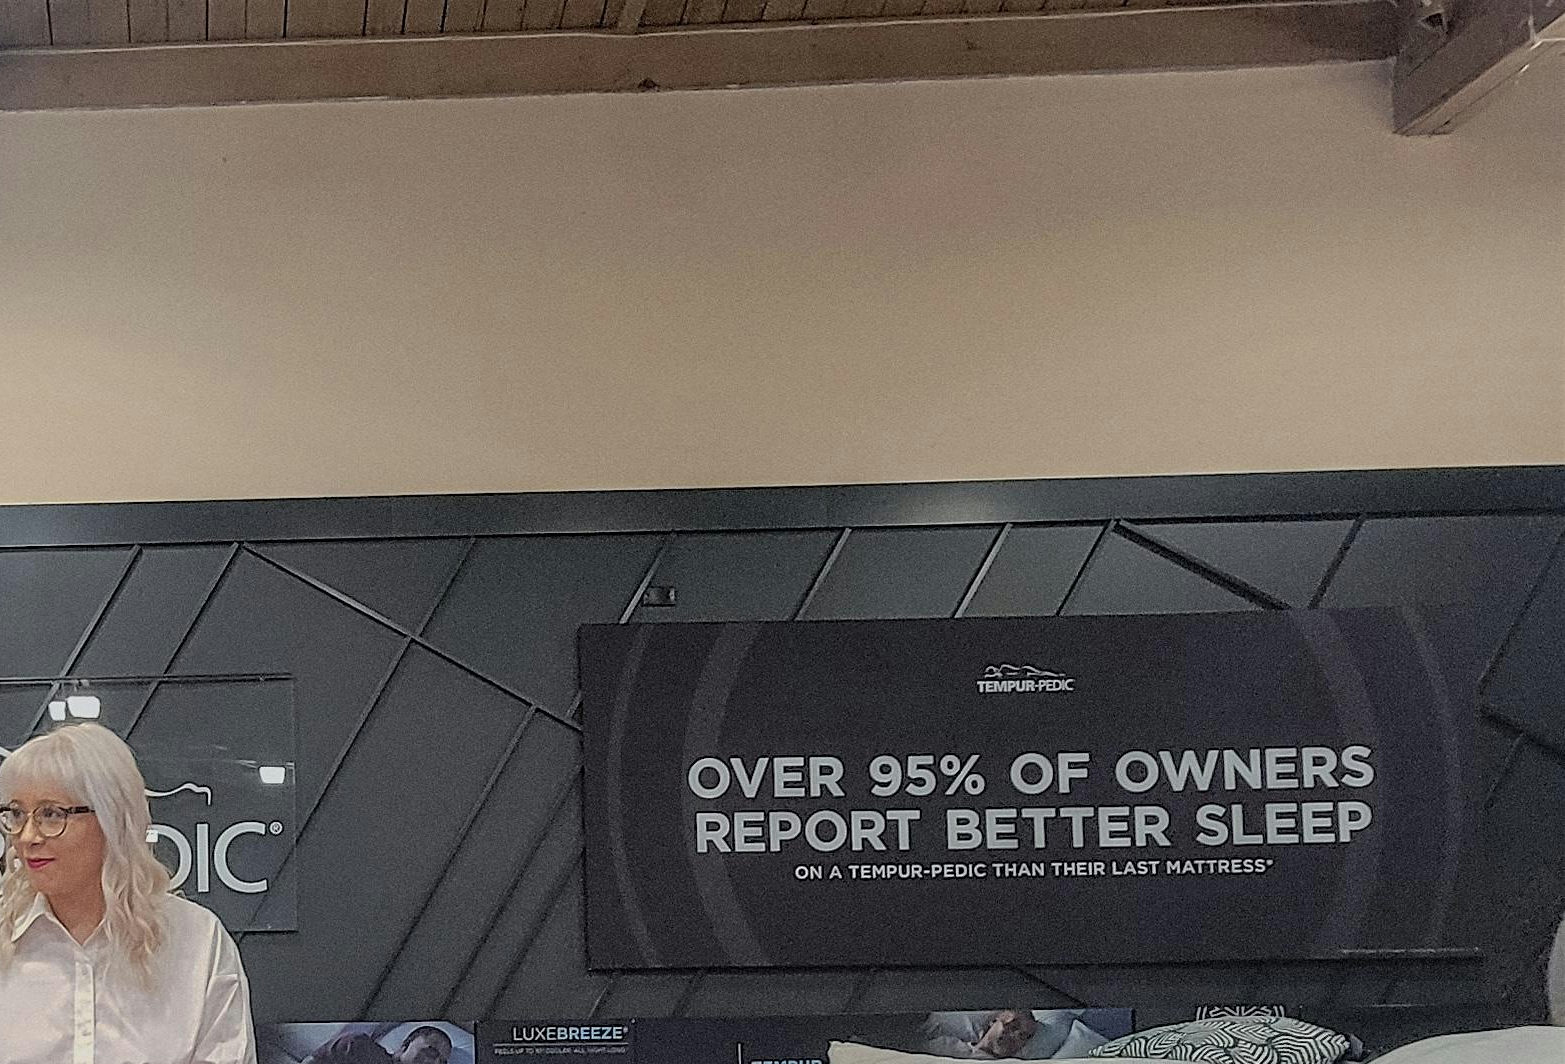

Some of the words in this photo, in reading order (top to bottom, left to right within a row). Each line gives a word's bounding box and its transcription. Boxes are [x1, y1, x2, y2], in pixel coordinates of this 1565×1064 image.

[977, 678, 1074, 693] TEMPUR-PEDIC
[687, 756, 846, 798] OVER
[868, 753, 985, 796] 95%
[1008, 751, 1090, 794] OF
[1113, 745, 1375, 792] OWNERS
[694, 809, 921, 853] REPORT
[946, 805, 1171, 851] BETTER
[1194, 801, 1374, 846] SLEEP
[795, 865, 823, 880] ON
[829, 865, 843, 879] A
[848, 863, 987, 879] TEMPUR-PEDIC
[992, 862, 1045, 877] THAN
[1050, 861, 1106, 876] THEIR
[1111, 860, 1160, 875] LAST
